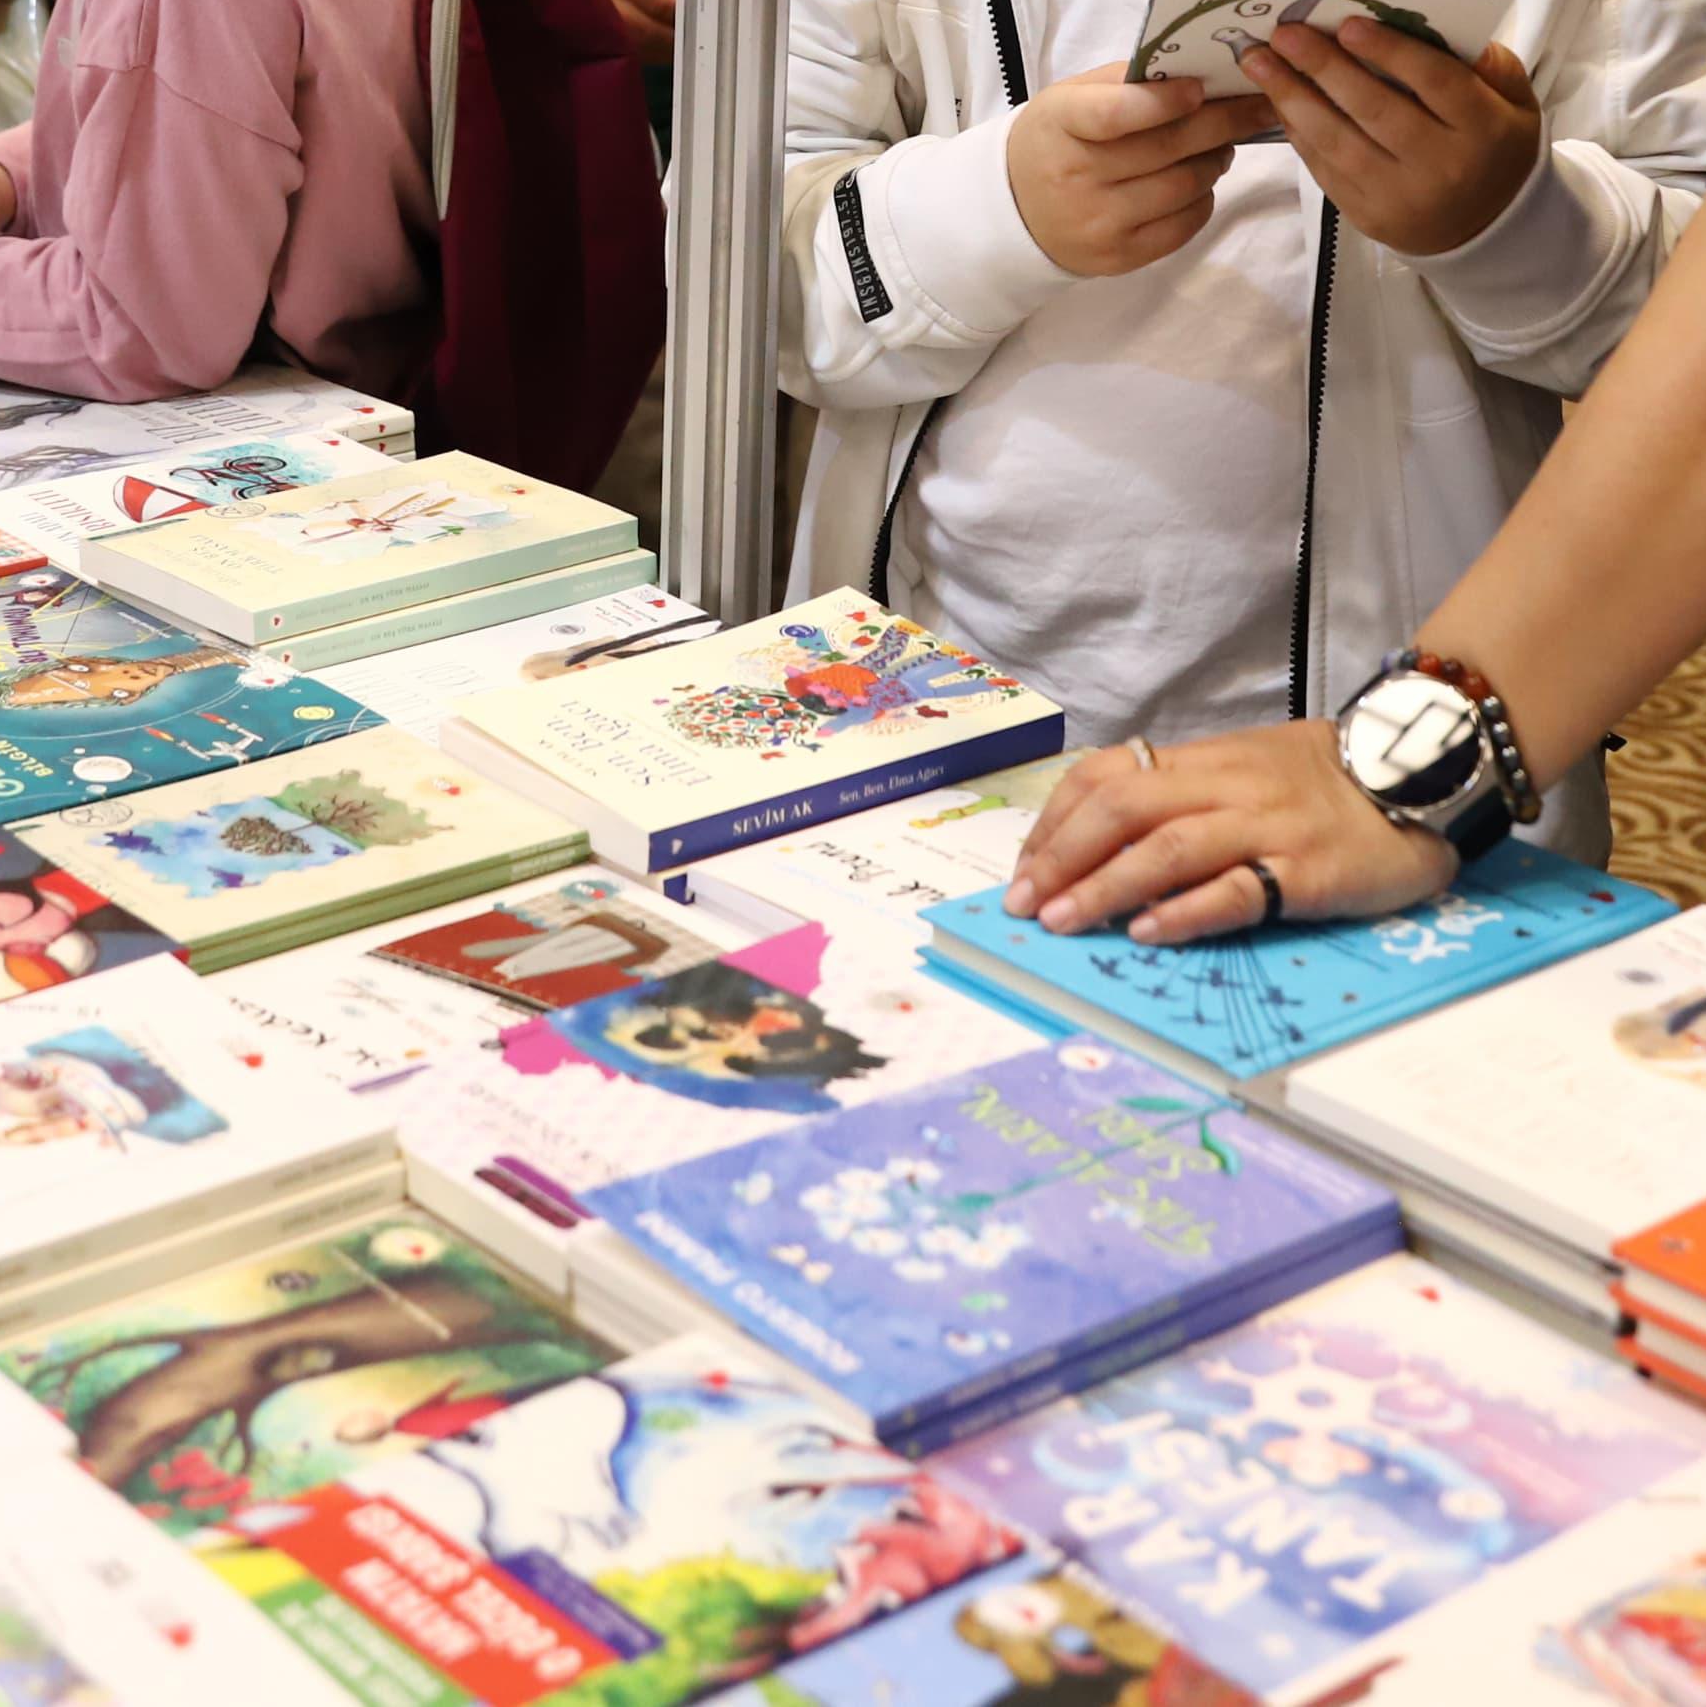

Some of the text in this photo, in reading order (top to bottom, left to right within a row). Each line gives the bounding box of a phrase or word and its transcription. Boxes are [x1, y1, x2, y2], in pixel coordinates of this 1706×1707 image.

[862, 782, 888, 801] Ben.
[888, 774, 915, 794] Elma
[732, 798, 816, 838] SEVİM AK
[1061, 1487, 1272, 1618] KAR
